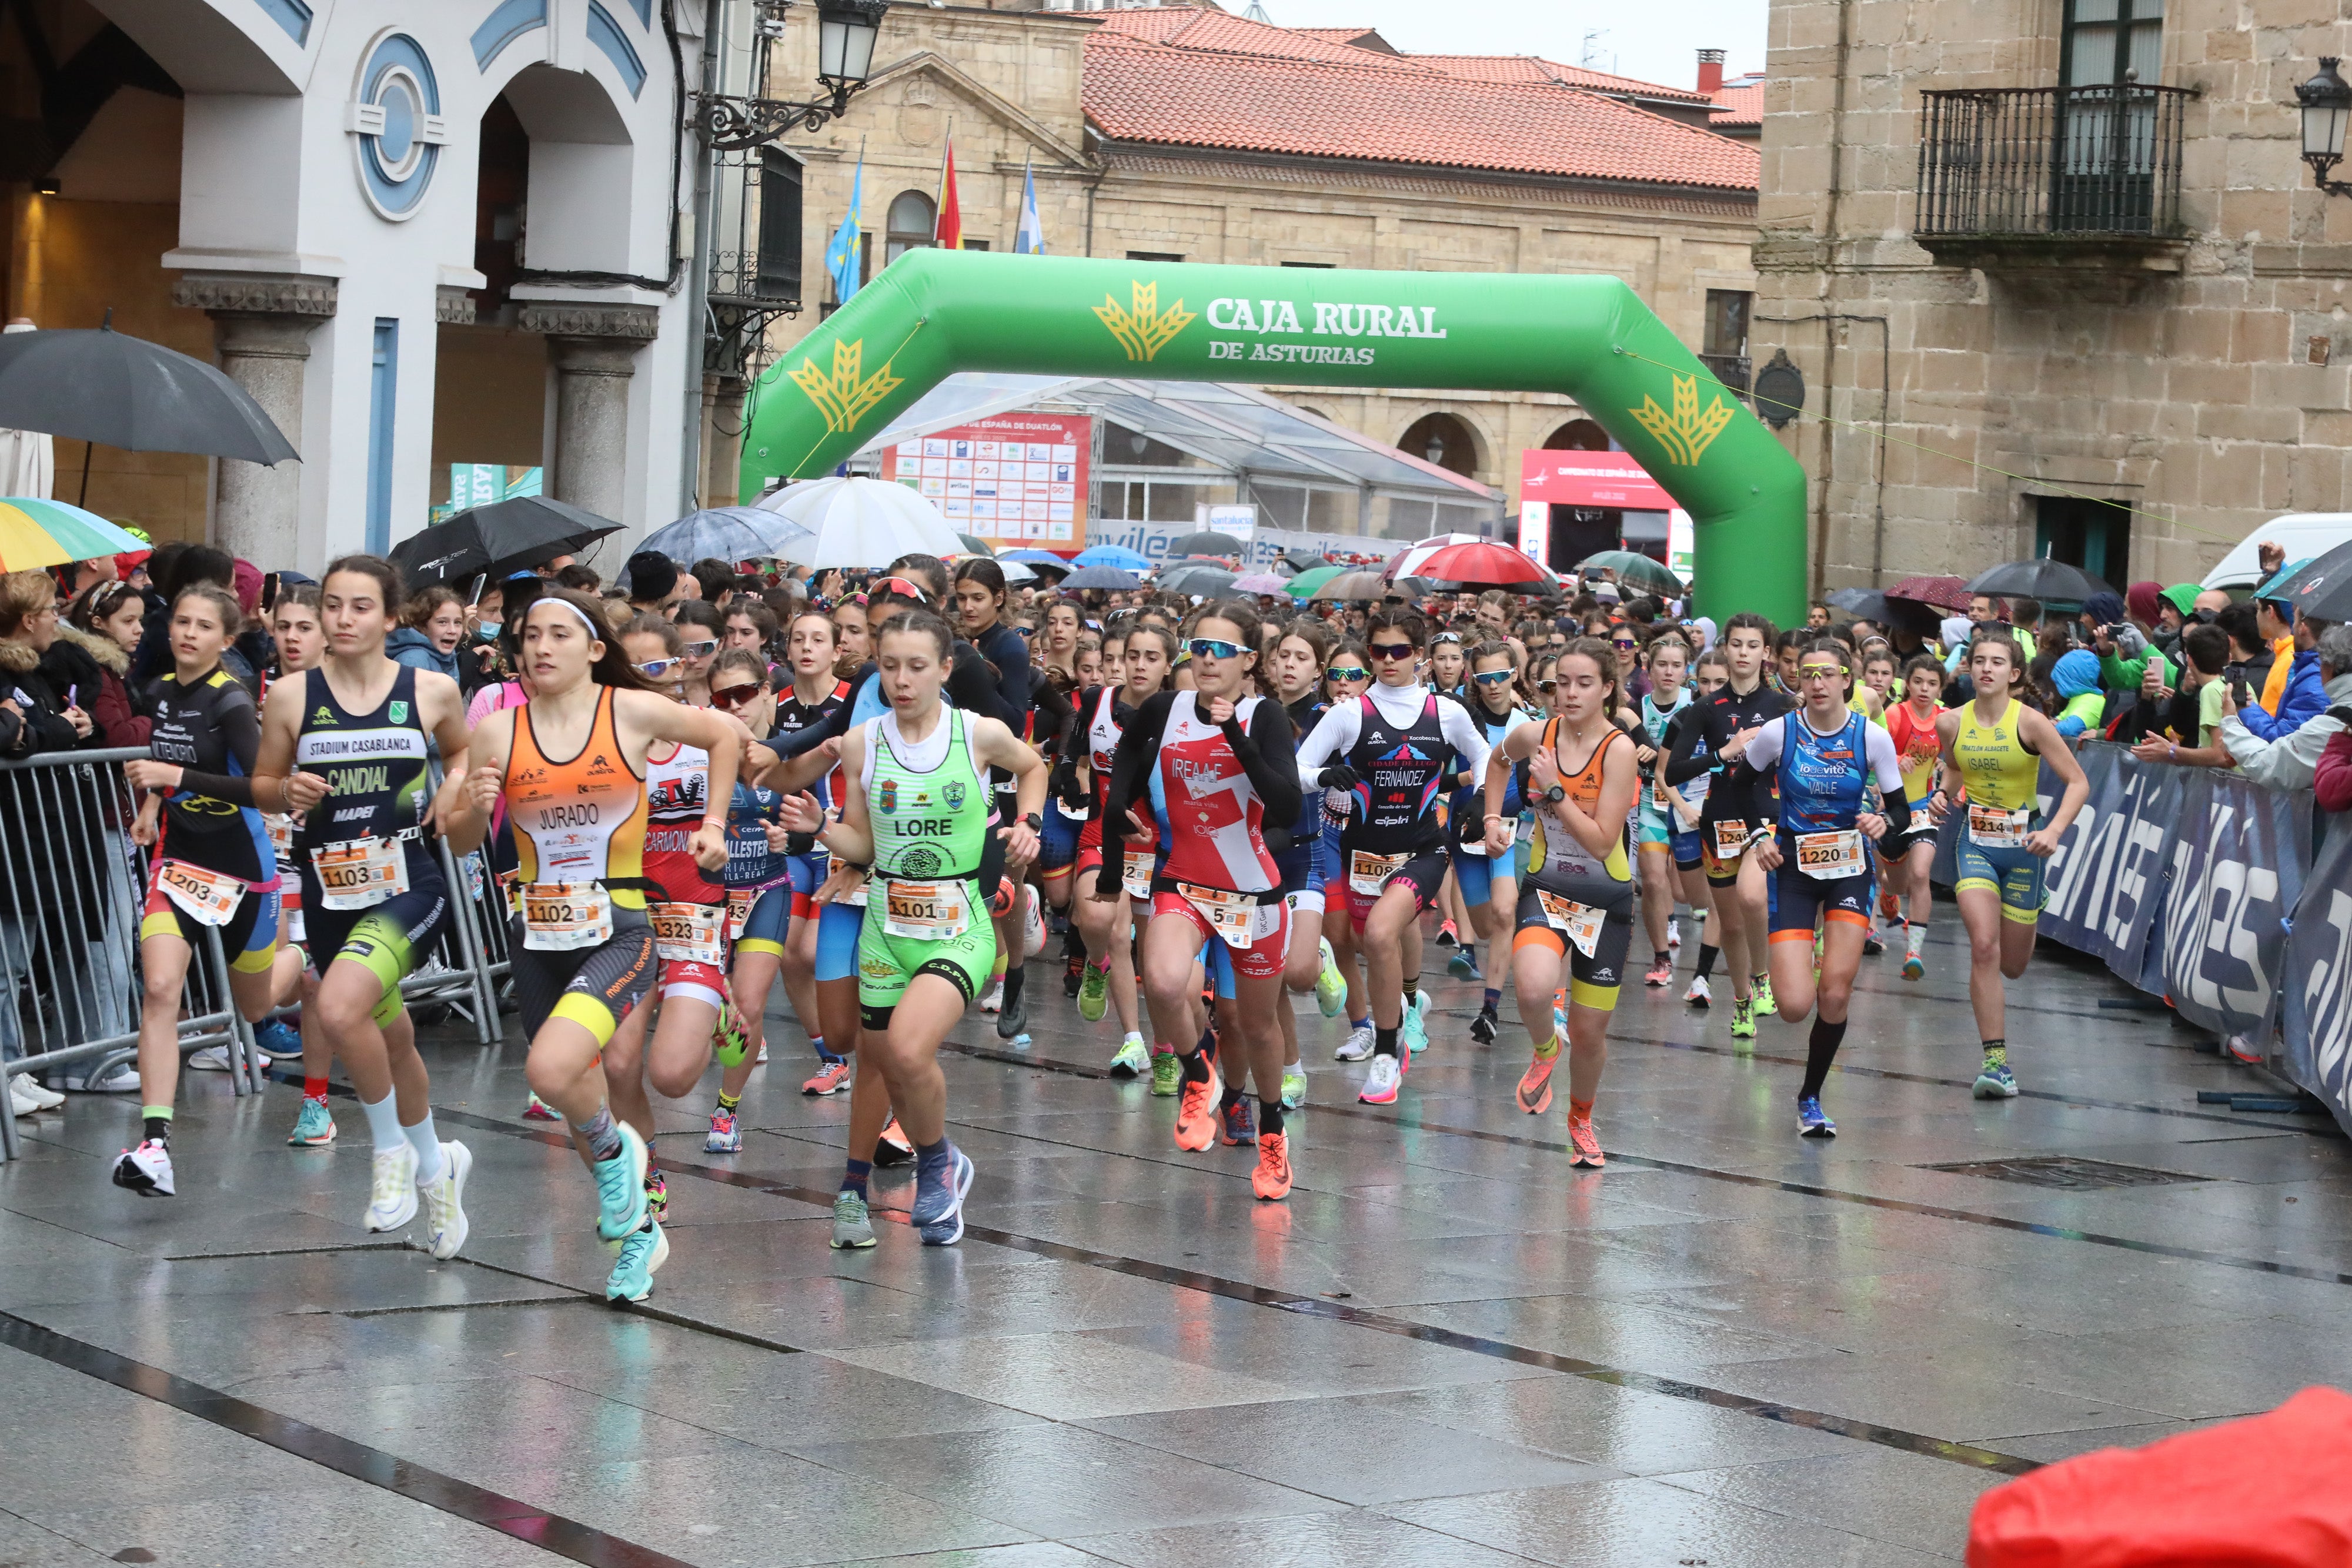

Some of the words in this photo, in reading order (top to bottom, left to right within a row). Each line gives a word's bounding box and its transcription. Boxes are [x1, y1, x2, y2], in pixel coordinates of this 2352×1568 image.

[1207, 297, 1304, 335] CAJA
[1312, 302, 1446, 339] RURAL
[1208, 341, 1245, 360] DE
[1248, 343, 1375, 365] ASTURIAS
[981, 420, 1012, 429] ESPAÑA
[1014, 422, 1024, 430] DE
[310, 741, 349, 756] STADIUM
[352, 737, 411, 753] CASABLANCA
[1967, 758, 2003, 771] ISABEL
[328, 765, 390, 797] CANDIAL
[1374, 767, 1426, 787] FERNÁNDEZ
[1808, 781, 1838, 795] VALLE
[332, 805, 376, 823] MAPEI
[539, 803, 599, 830] JURADO
[894, 818, 953, 837] LORE
[1971, 819, 2005, 834] 1214
[645, 830, 692, 852] CARMONA
[1799, 848, 1840, 864] 1220
[324, 867, 369, 887] 1103
[1125, 866, 1135, 878] 2
[164, 868, 211, 901] 1203
[527, 904, 573, 922] 1102
[888, 900, 937, 919] 1101
[1839, 901, 1860, 910] austral
[1214, 908, 1224, 923] 5
[654, 921, 693, 940] 1323
